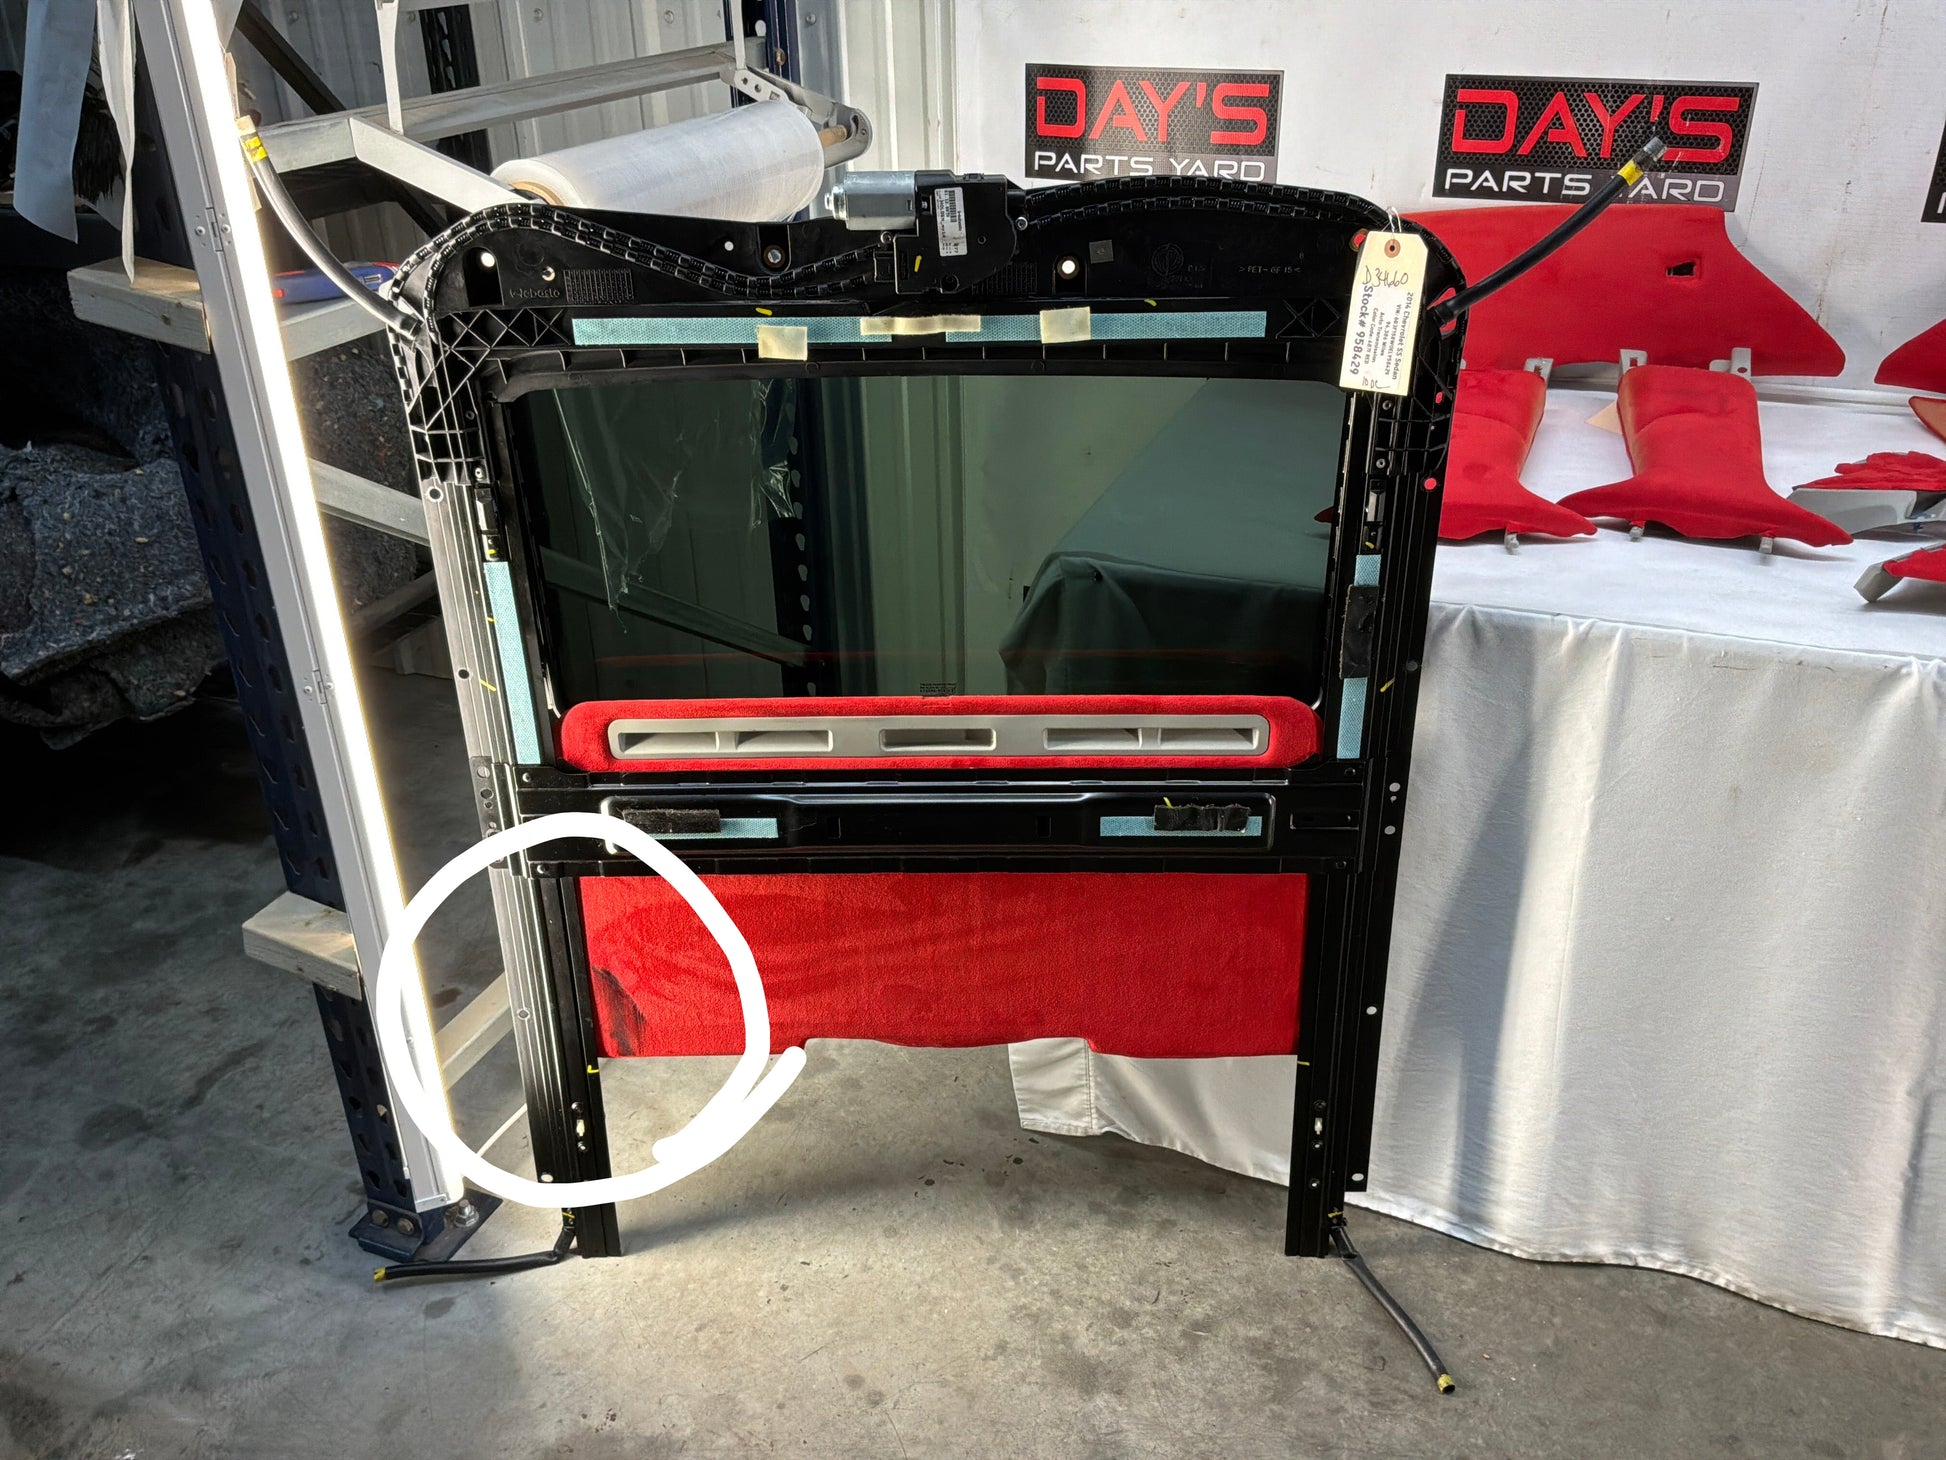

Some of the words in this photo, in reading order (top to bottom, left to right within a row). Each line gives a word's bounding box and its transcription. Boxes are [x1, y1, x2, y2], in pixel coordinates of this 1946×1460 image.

[1036, 76, 1270, 146] DAY'S
[1451, 88, 1740, 163] DAY'S
[1034, 151, 1154, 176] PARTS
[1169, 158, 1265, 182] YARD
[1445, 168, 1593, 195] PARTS
[1610, 172, 1725, 202] ARD
[1358, 285, 1373, 327] Stock#
[1372, 327, 1382, 363] Transmission
[1398, 311, 1410, 346] Chevrolet
[1350, 331, 1365, 375] 958429
[1392, 358, 1401, 380] Sedan
[1396, 348, 1403, 356] SS
